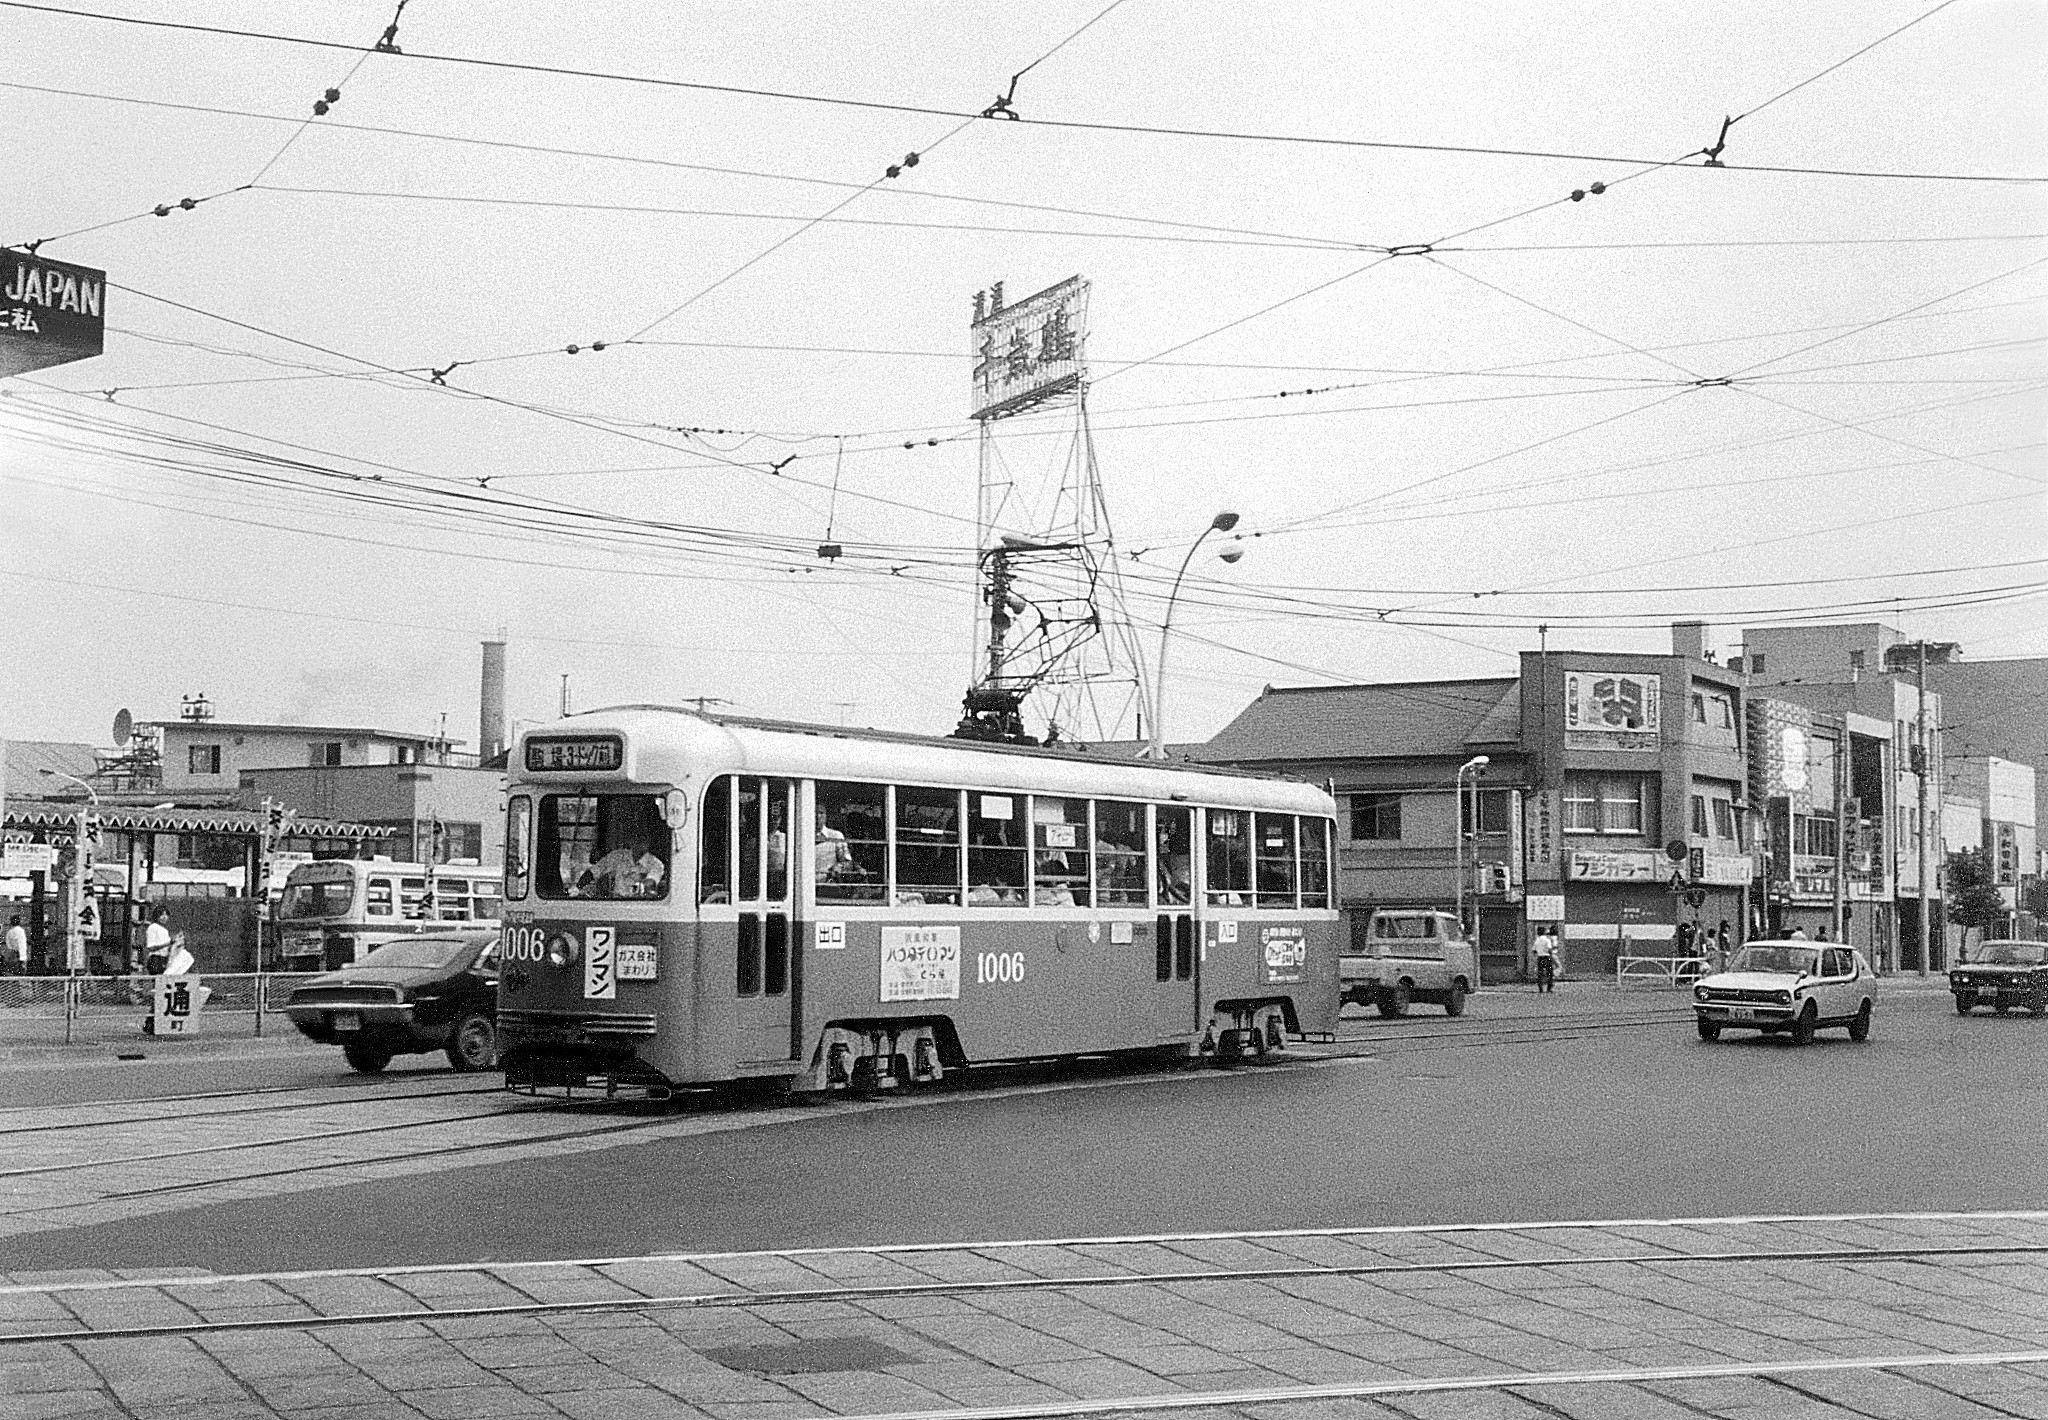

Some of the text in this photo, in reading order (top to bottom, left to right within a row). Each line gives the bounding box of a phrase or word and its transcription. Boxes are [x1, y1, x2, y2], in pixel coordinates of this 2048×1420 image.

[6, 262, 101, 316] JAPAN
[1574, 862, 1650, 877] フジカラー
[819, 926, 842, 943] 出口
[1221, 924, 1235, 937] 入口
[501, 927, 545, 961] 1006
[592, 930, 610, 995] ワンマン
[619, 950, 656, 963] ガス会社
[977, 952, 1025, 983] 1006
[622, 966, 650, 976] まわり
[163, 981, 191, 1017] 通
